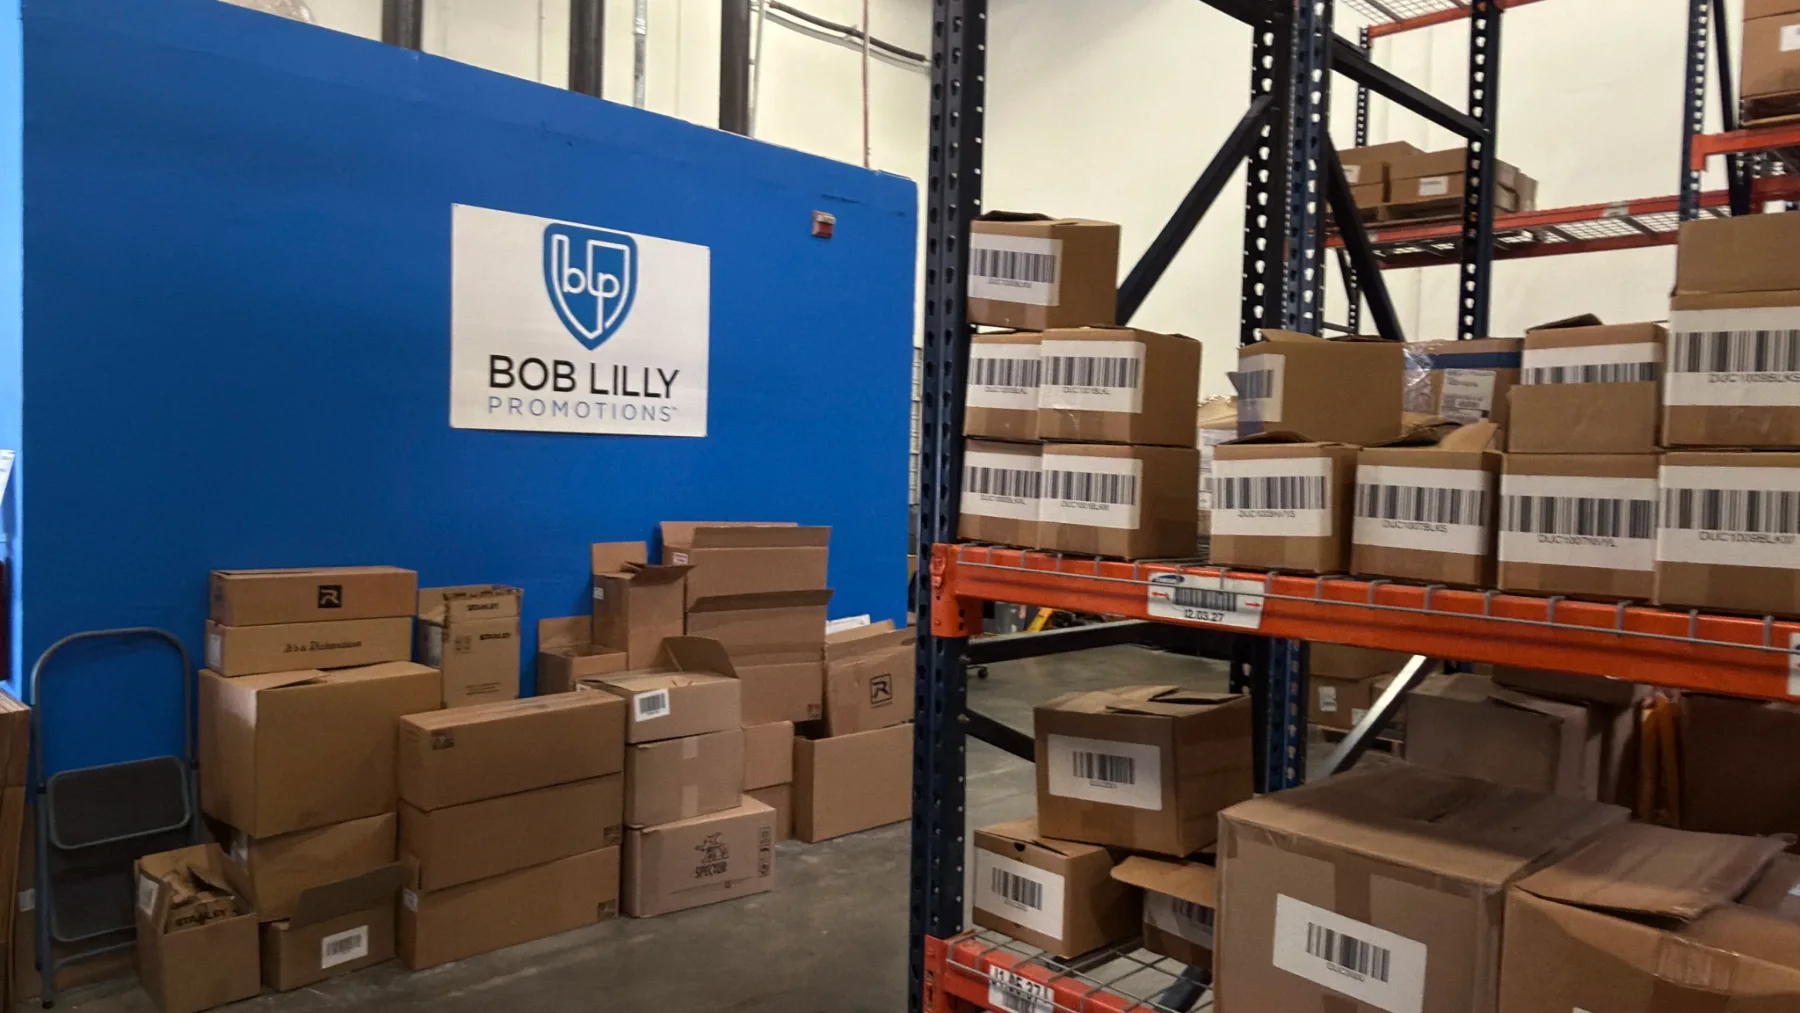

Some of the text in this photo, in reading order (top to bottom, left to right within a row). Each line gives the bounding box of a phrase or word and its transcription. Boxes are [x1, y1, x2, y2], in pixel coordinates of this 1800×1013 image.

[489, 354, 680, 398] BOB LILLY
[488, 395, 672, 422] PROMOTIONS
[1184, 608, 1225, 622] 12.03.27
